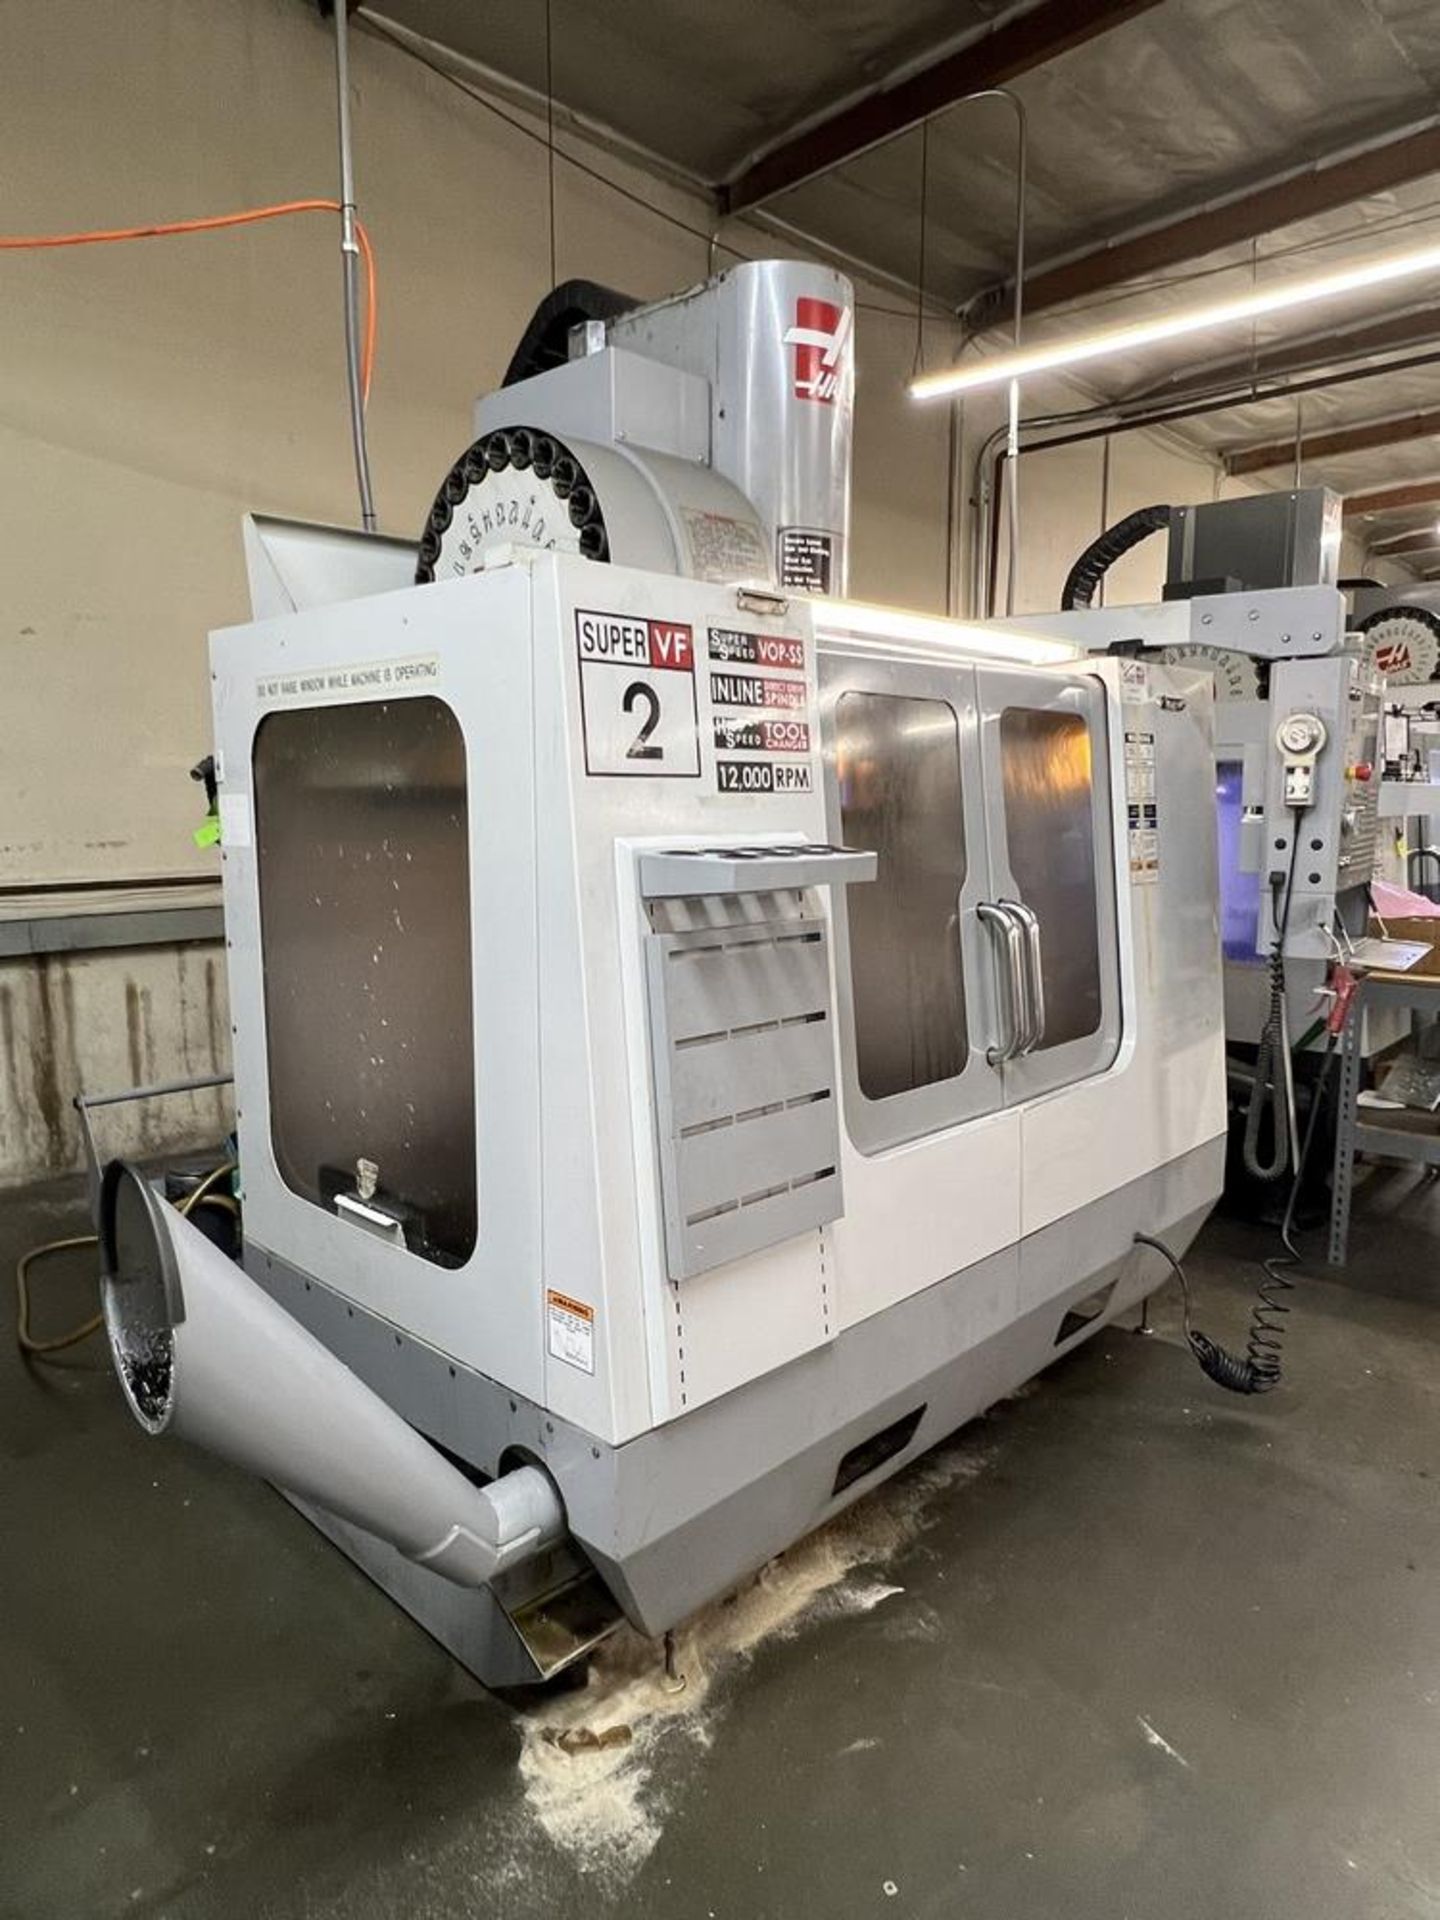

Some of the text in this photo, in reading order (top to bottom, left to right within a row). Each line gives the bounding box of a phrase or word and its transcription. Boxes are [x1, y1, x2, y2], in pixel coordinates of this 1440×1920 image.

[583, 621, 687, 664] SUPER VF
[710, 628, 747, 646] SUPER
[719, 644, 755, 660] SPEED
[712, 677, 762, 704] INLINE
[623, 681, 663, 760] 2
[726, 723, 807, 748] SPEED TOOL
[719, 765, 809, 790] 12,000 RPM
